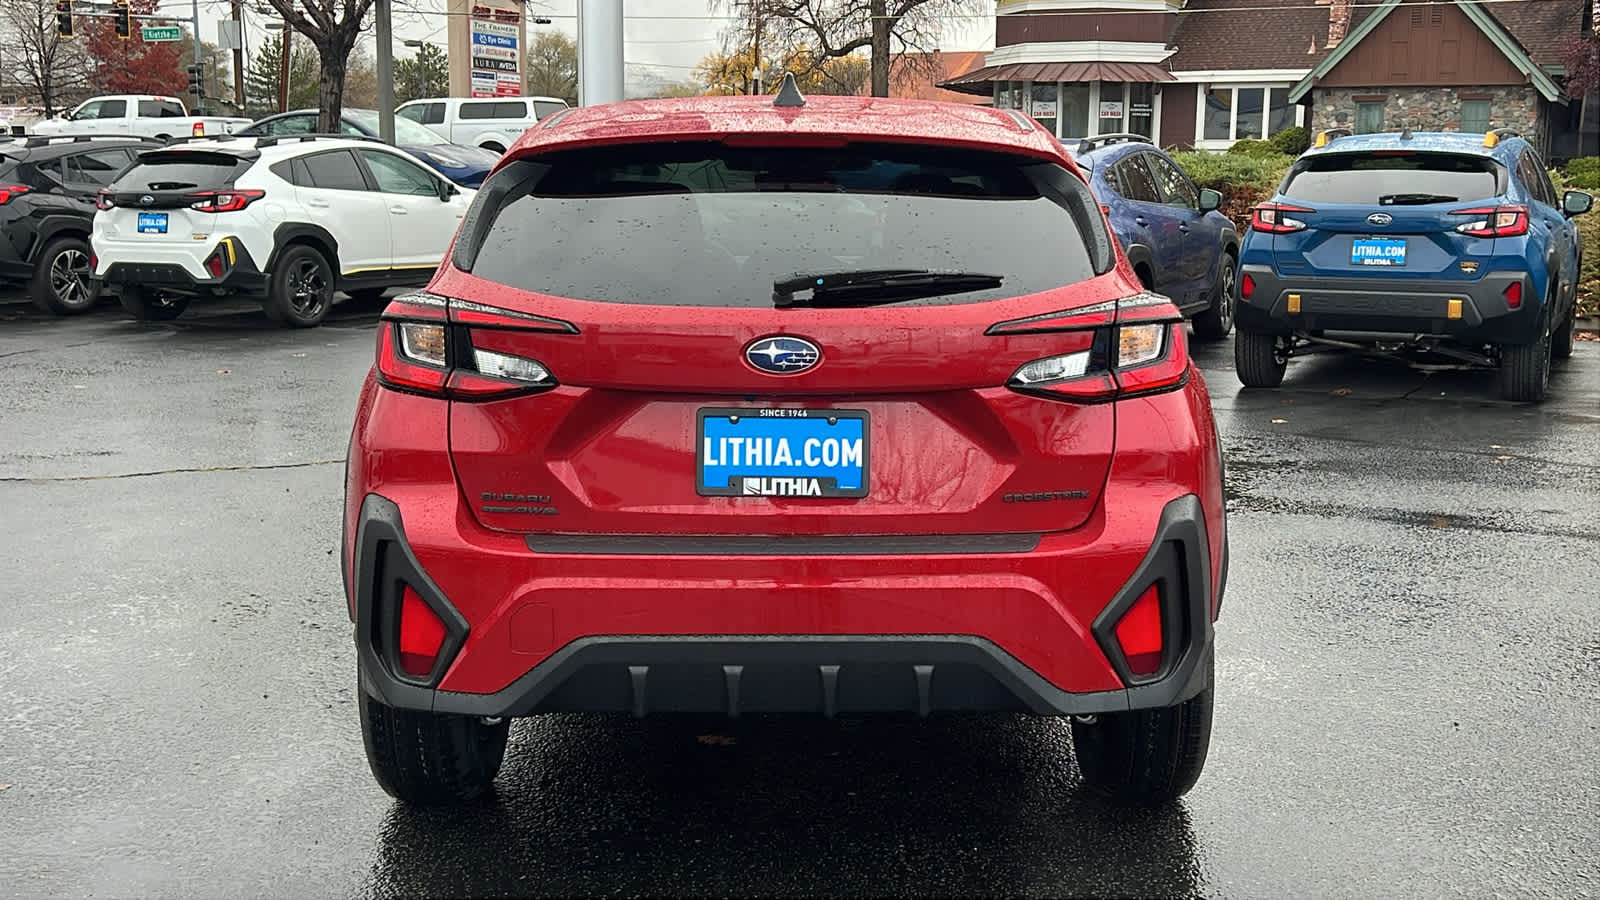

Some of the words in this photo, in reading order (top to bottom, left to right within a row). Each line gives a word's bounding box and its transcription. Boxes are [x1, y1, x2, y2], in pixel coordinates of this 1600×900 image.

[499, 62, 516, 71] AVEDA
[1352, 245, 1406, 257] LITHIA.COM
[760, 409, 785, 417] SINCE
[788, 409, 808, 417] 1946
[704, 437, 863, 467] LITHIA.COM
[761, 478, 822, 496] LITHIA
[482, 492, 551, 504] SUBARU
[1003, 490, 1089, 503] CROSSTREK
